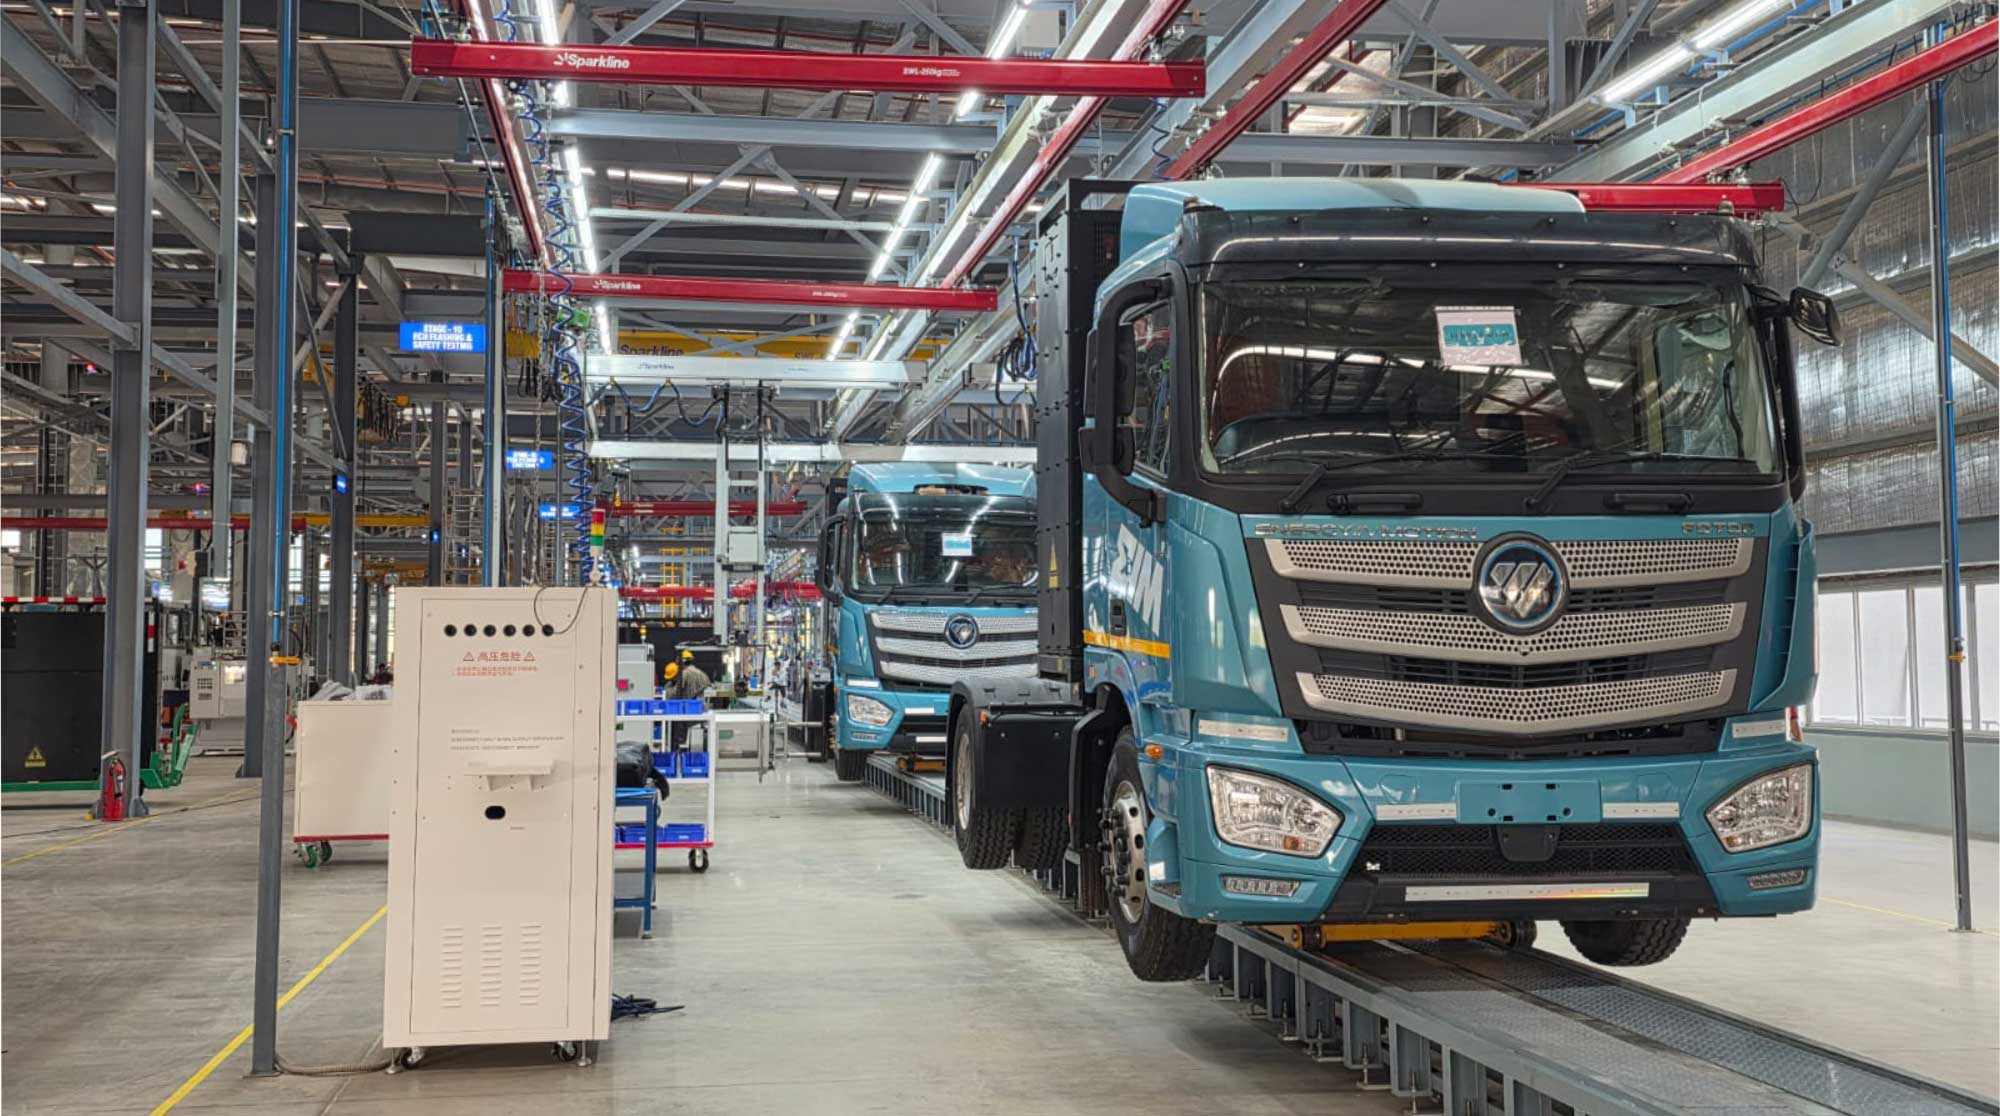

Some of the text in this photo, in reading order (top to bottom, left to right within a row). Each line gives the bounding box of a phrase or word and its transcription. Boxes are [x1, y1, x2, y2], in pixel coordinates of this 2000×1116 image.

[567, 53, 630, 69] Sparkline
[423, 324, 447, 333] STAGE
[428, 332, 465, 341] FLASHING
[412, 341, 440, 350] SAFETY
